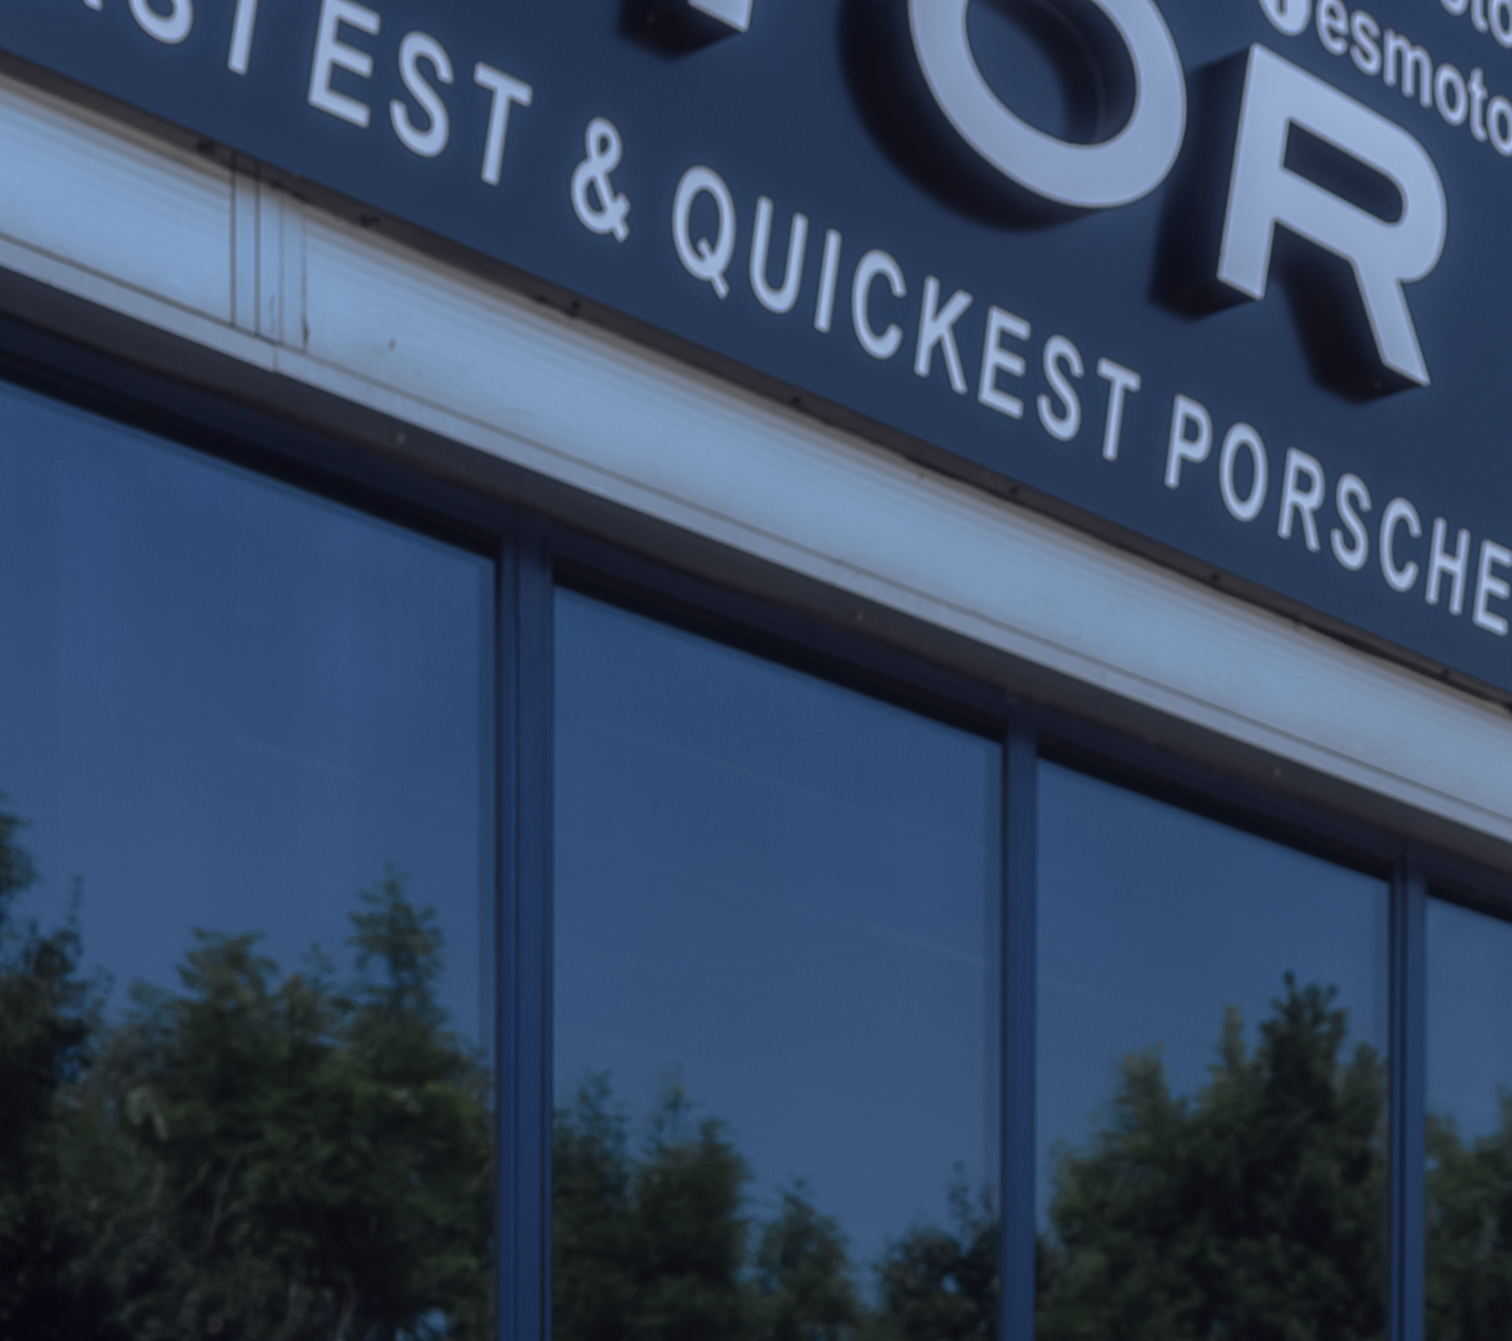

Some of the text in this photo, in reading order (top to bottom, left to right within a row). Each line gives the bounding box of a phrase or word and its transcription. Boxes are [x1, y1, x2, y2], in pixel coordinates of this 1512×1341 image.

[571, 117, 631, 243] &
[671, 164, 1142, 462] QUICKEST
[688, 0, 1447, 386] OR
